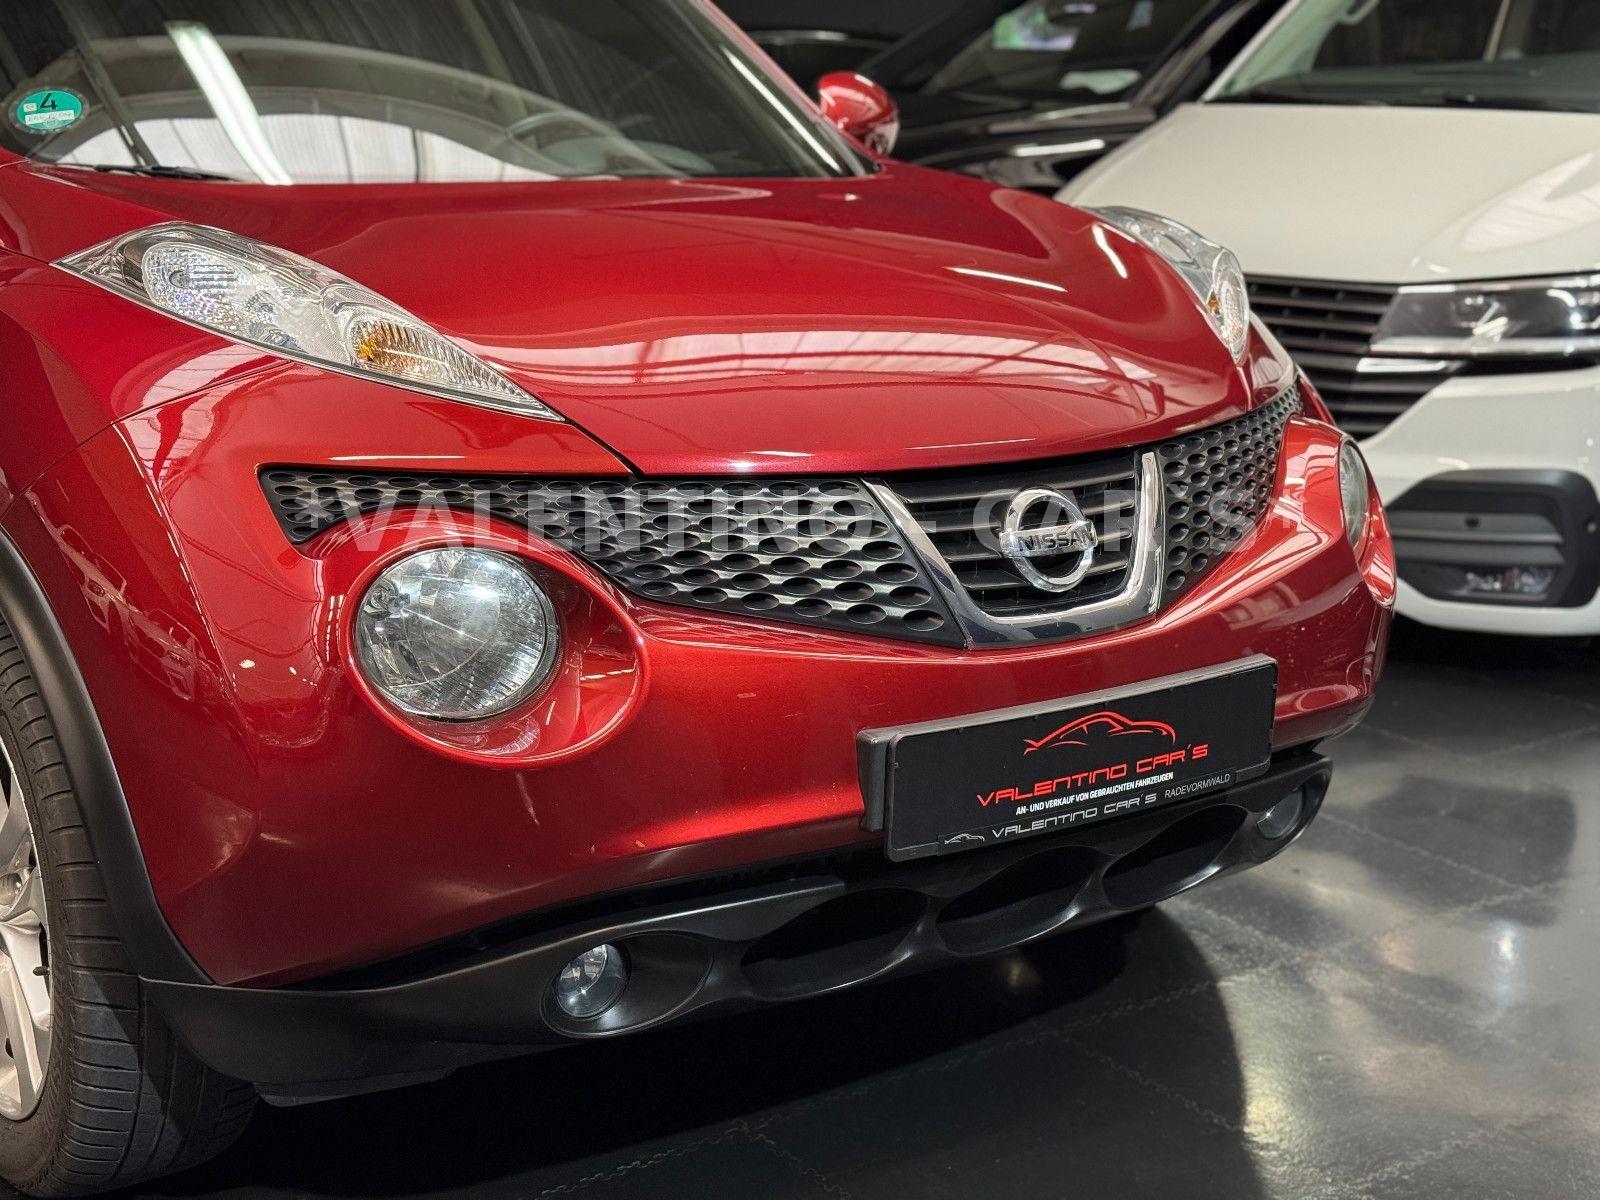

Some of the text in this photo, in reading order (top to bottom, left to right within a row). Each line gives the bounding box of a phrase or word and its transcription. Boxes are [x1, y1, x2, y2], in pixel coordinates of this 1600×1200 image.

[40, 93, 57, 109] 4
[1017, 527, 1095, 551] NISSAN
[977, 764, 1127, 807] VALENTINO
[992, 807, 1097, 838] VALENTINO
[1164, 773, 1230, 799] RADEVORMWALD
[1016, 772, 1174, 815] AN- UND VERKAUF VON GEBRAUCHTEN FAHRZEUGEN
